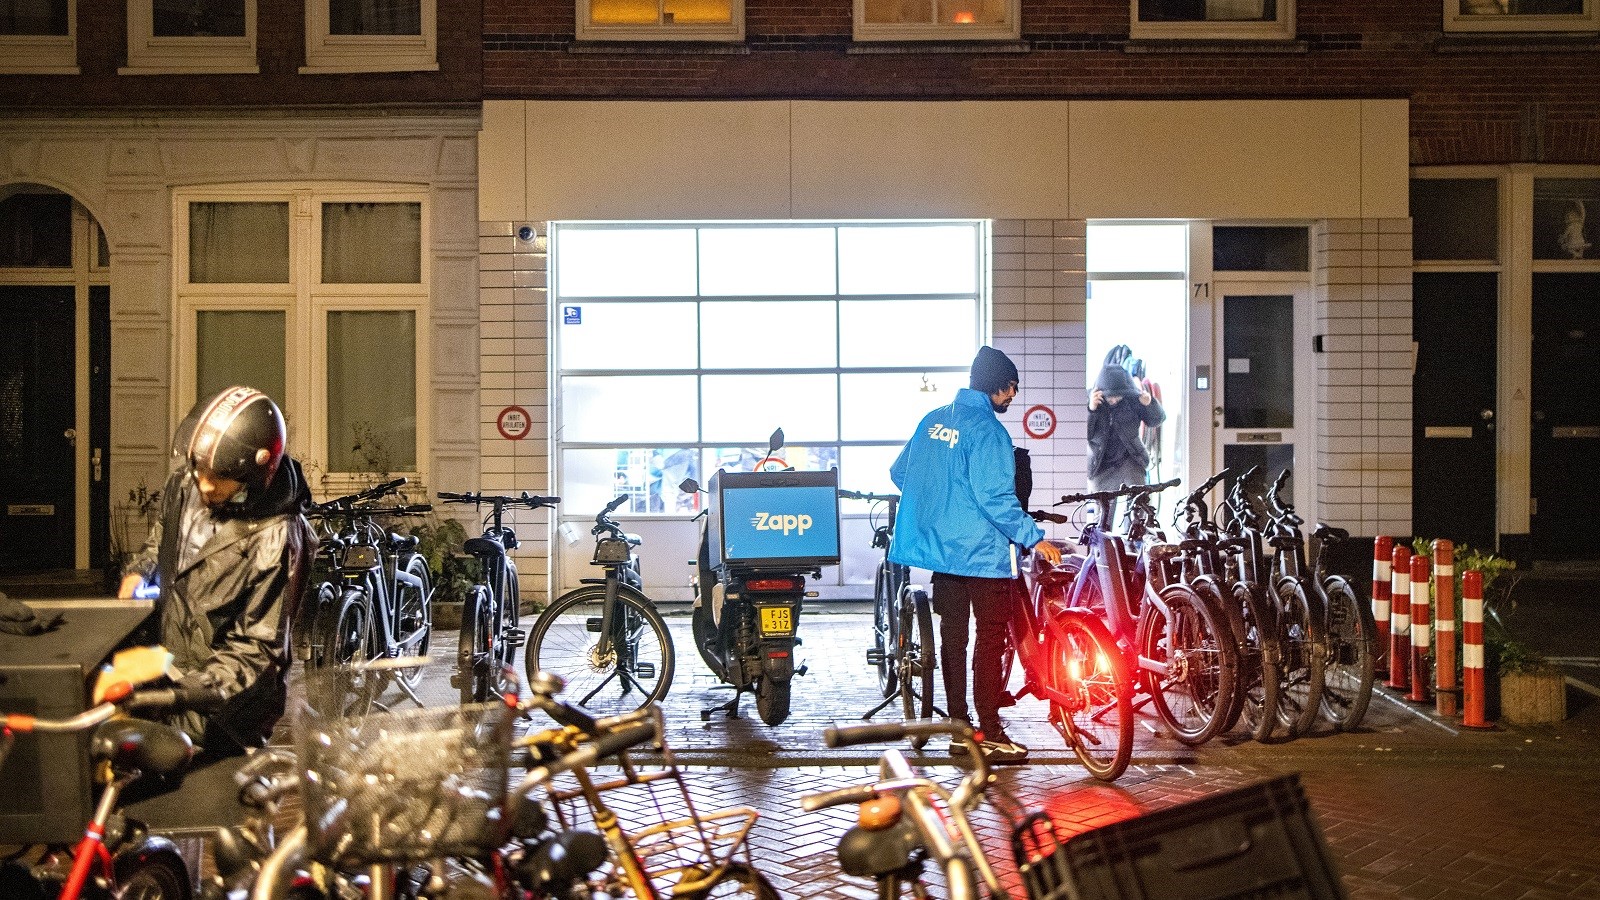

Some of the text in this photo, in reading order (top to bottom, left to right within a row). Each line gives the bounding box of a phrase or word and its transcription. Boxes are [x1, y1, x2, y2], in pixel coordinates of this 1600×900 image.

[1194, 283, 1208, 297] 71
[754, 512, 813, 536] Zapp
[771, 610, 789, 619] FJS
[771, 620, 789, 629] 31Z
